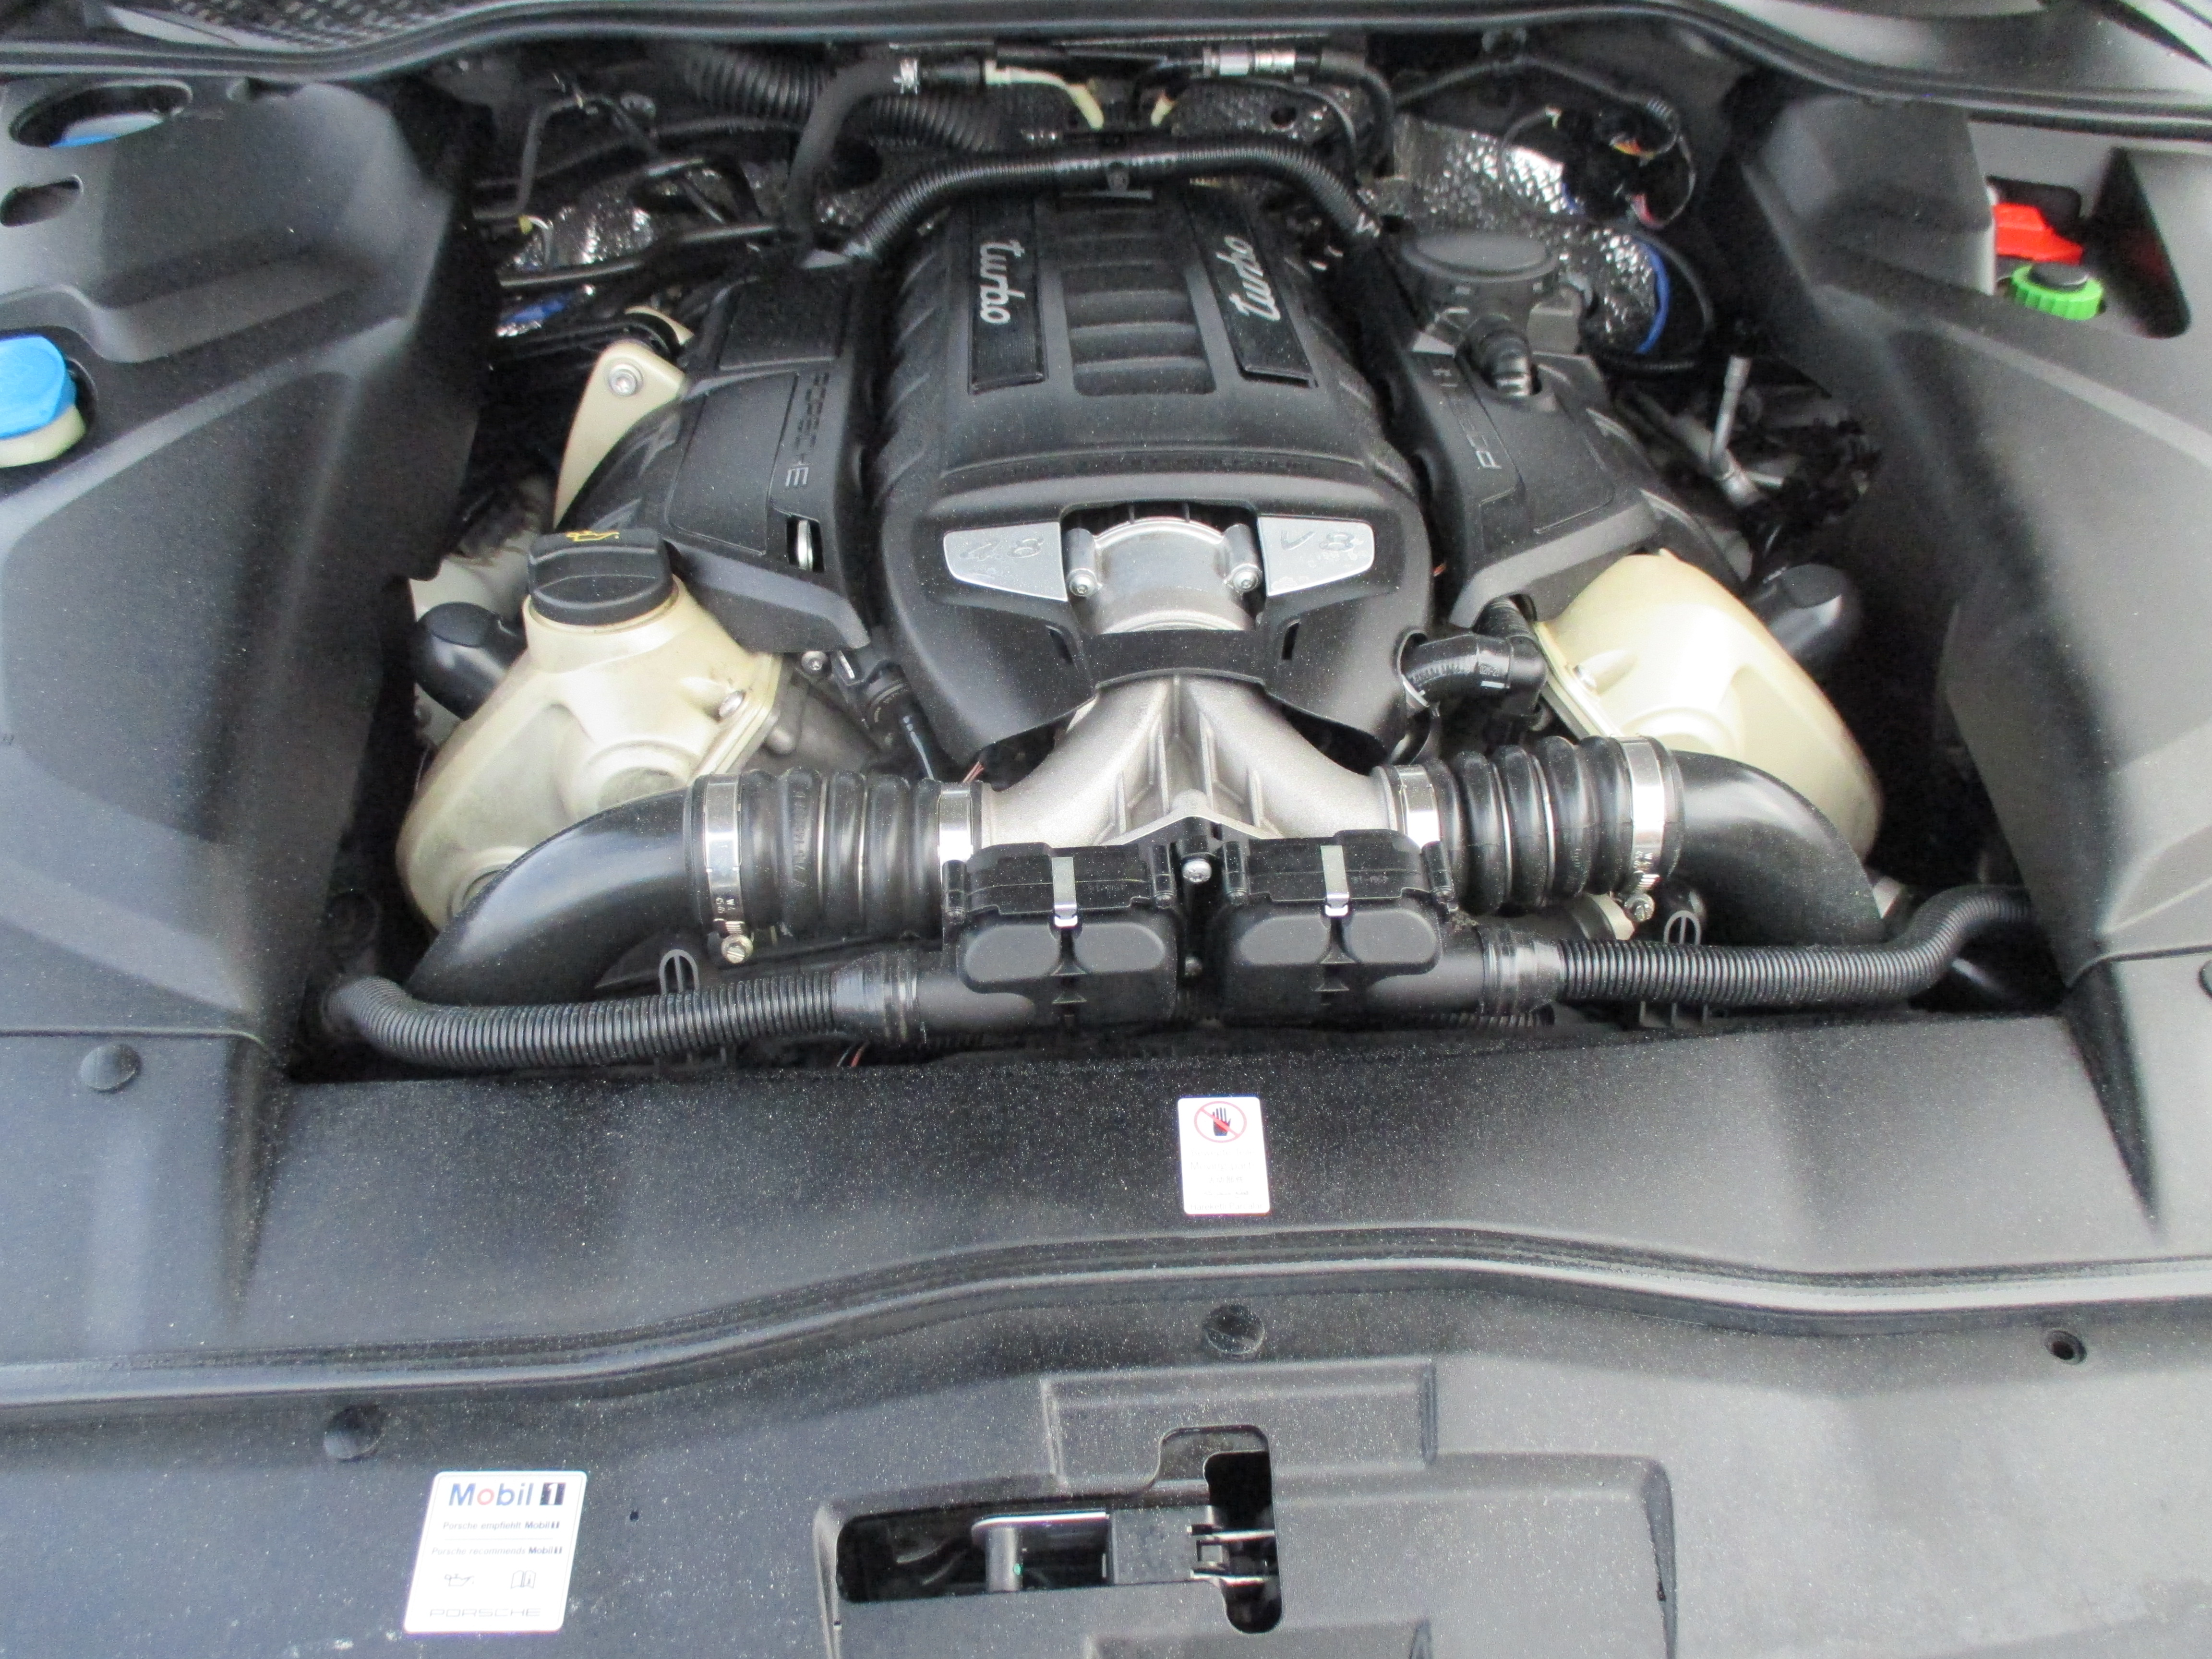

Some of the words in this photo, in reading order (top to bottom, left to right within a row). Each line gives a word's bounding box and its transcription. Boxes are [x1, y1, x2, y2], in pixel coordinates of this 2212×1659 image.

[979, 239, 1026, 325] turbo
[1215, 235, 1281, 322] turbo
[448, 1482, 534, 1506] Mobil
[443, 1521, 478, 1530] Porsche
[481, 1521, 521, 1531] empfiehlt
[432, 1547, 466, 1555] Porsche
[469, 1547, 526, 1555] recommends
[430, 1608, 541, 1617] PORSCHE
